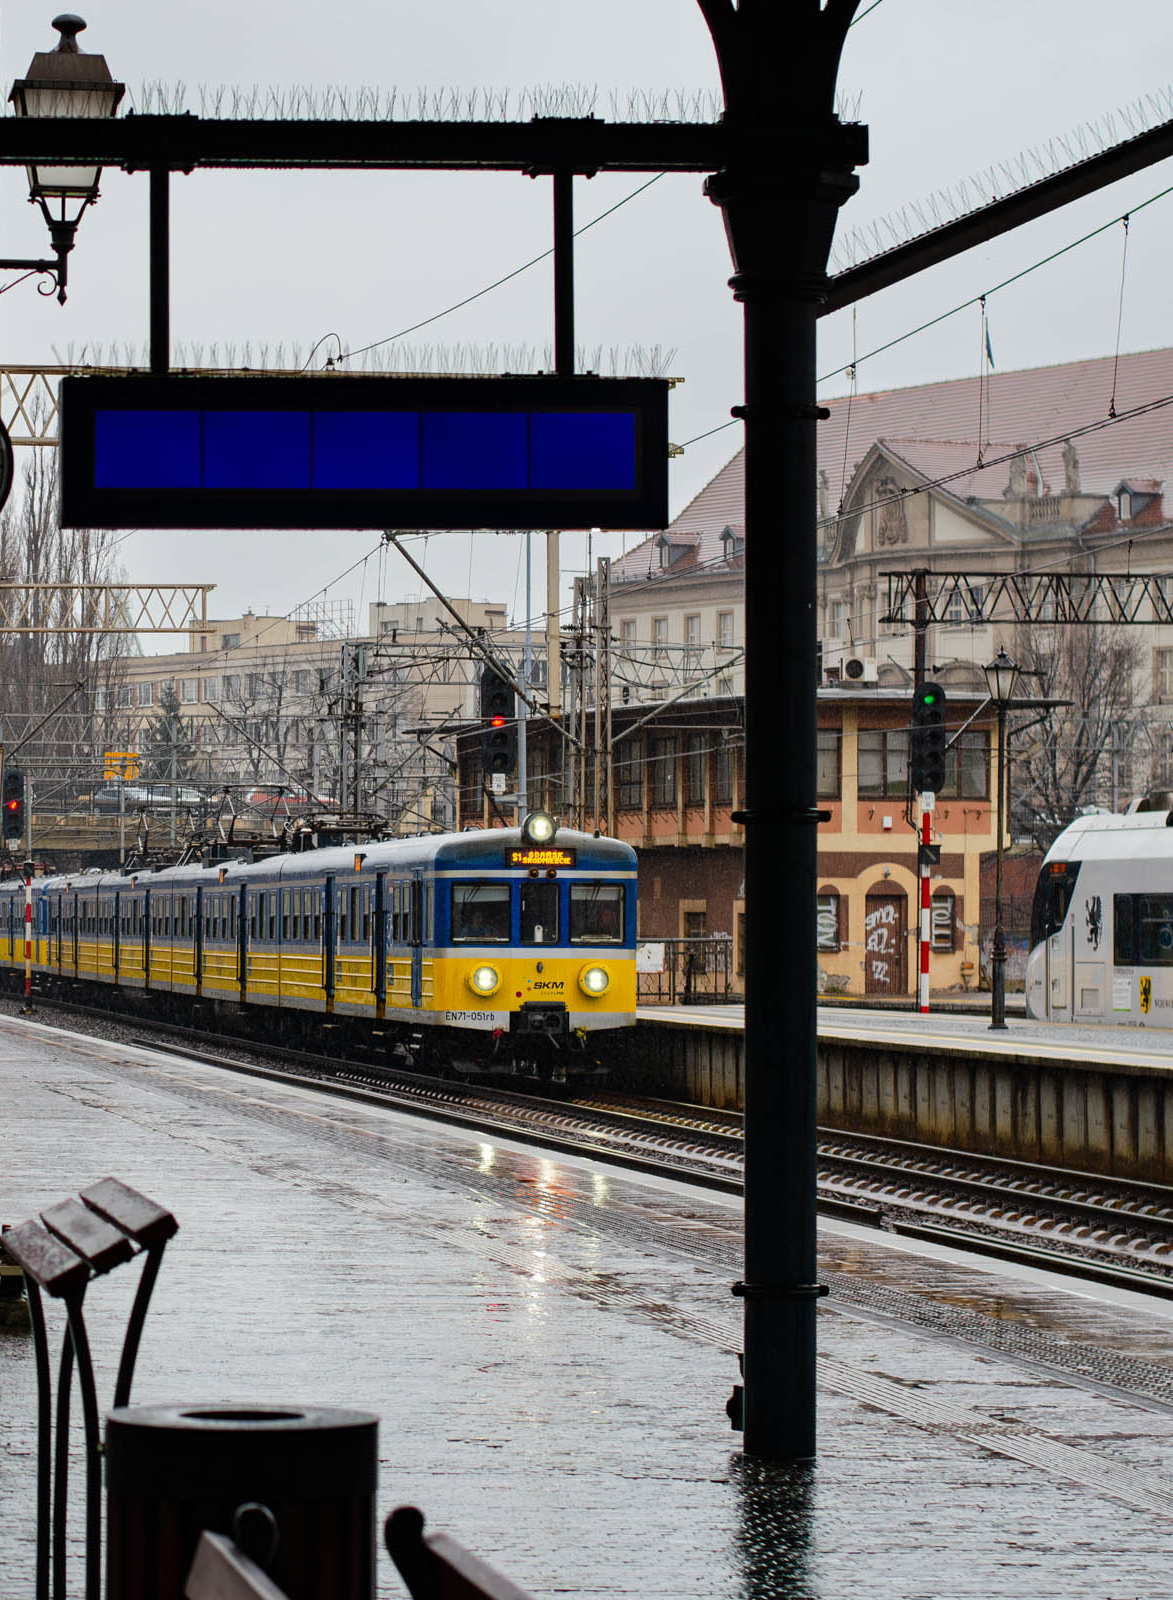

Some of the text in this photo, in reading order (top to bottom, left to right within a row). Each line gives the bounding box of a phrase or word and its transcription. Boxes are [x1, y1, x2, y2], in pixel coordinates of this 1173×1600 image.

[512, 852, 522, 862] S1
[533, 981, 565, 990] SKM
[445, 1011, 495, 1021] EN71-051rb
